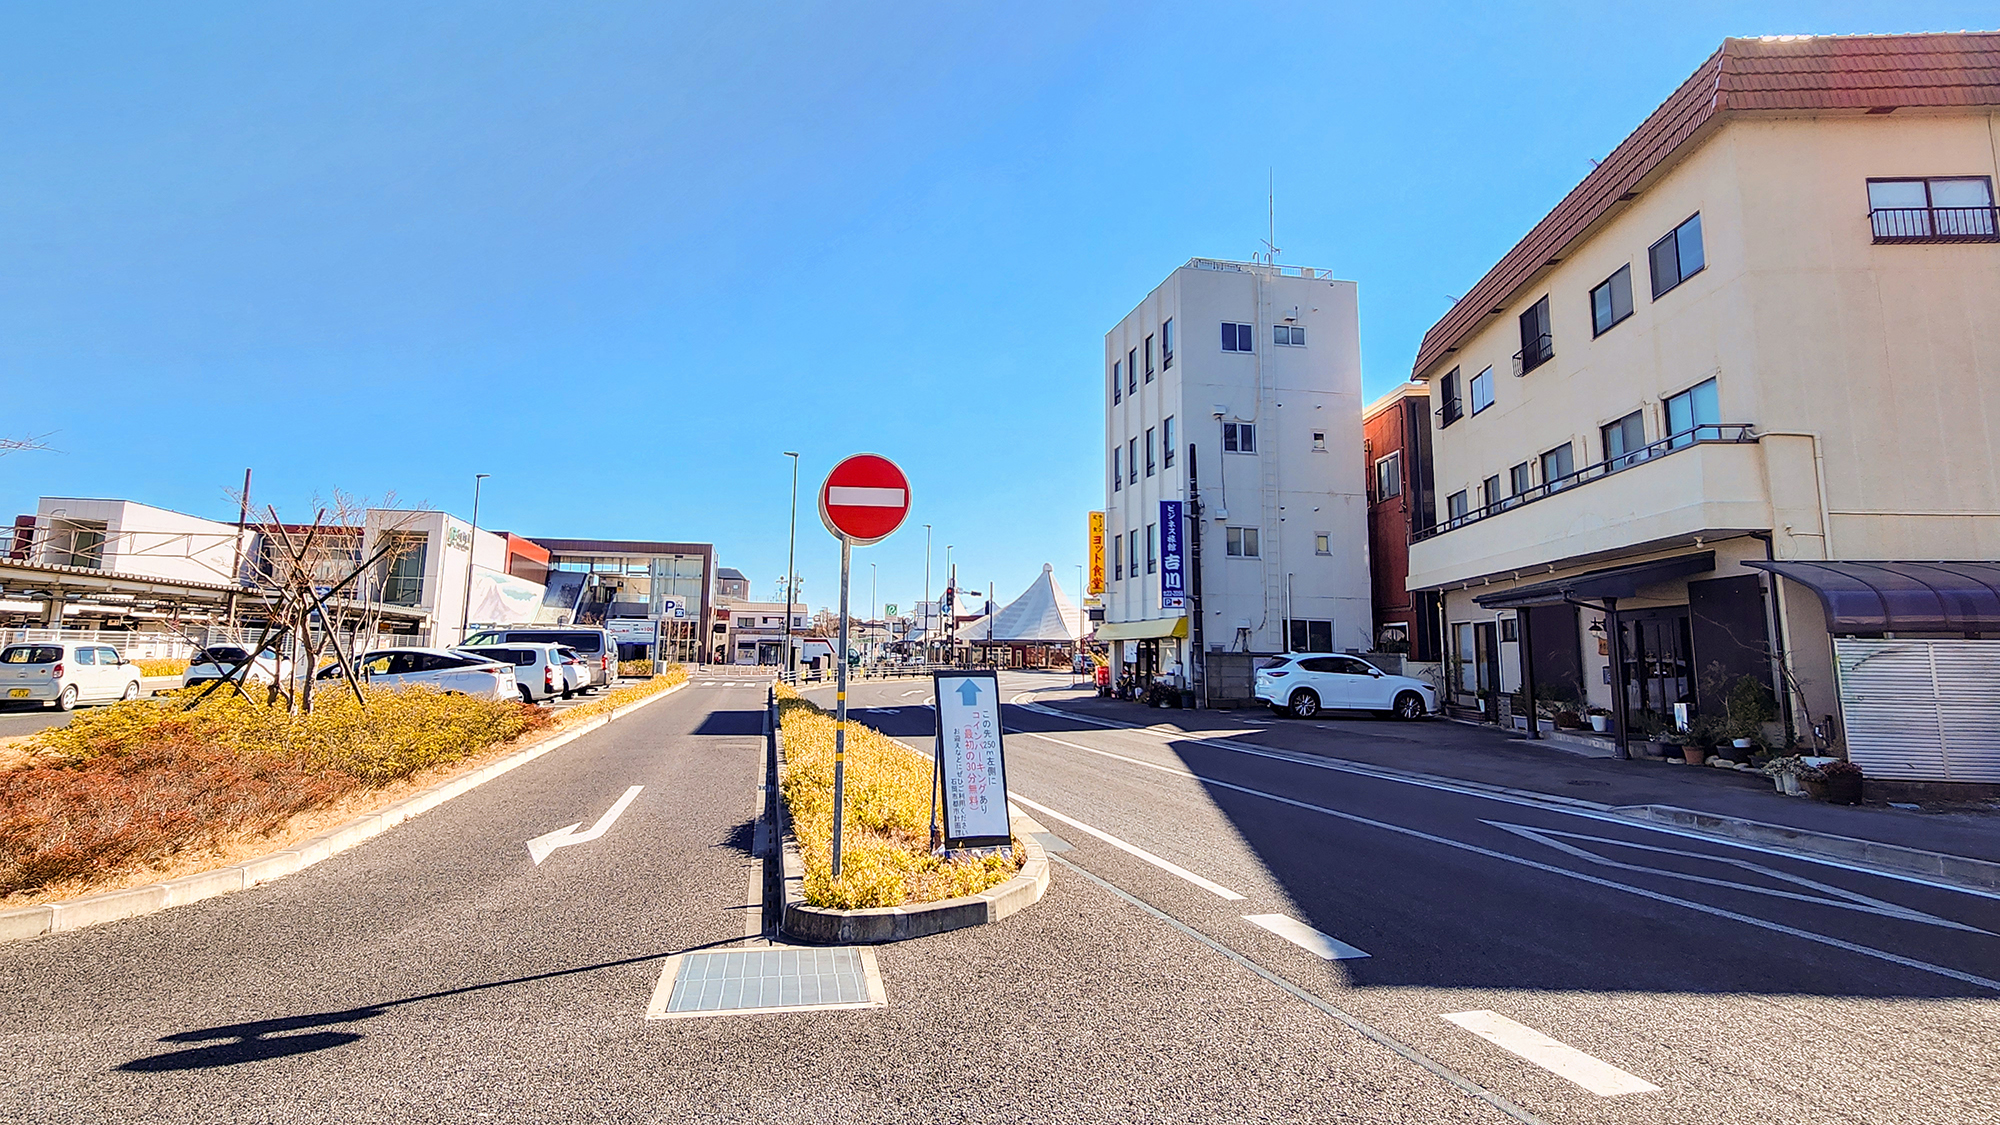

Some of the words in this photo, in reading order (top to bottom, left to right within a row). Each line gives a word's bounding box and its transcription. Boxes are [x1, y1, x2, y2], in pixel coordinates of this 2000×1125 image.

[1167, 504, 1177, 552] ビジネス旅館
[1091, 535, 1104, 590] ヨット食堂
[1164, 553, 1181, 589] 吉川
[665, 600, 676, 613] P
[972, 711, 988, 815] コインパーキングあり
[982, 710, 997, 786] この先250m左側に
